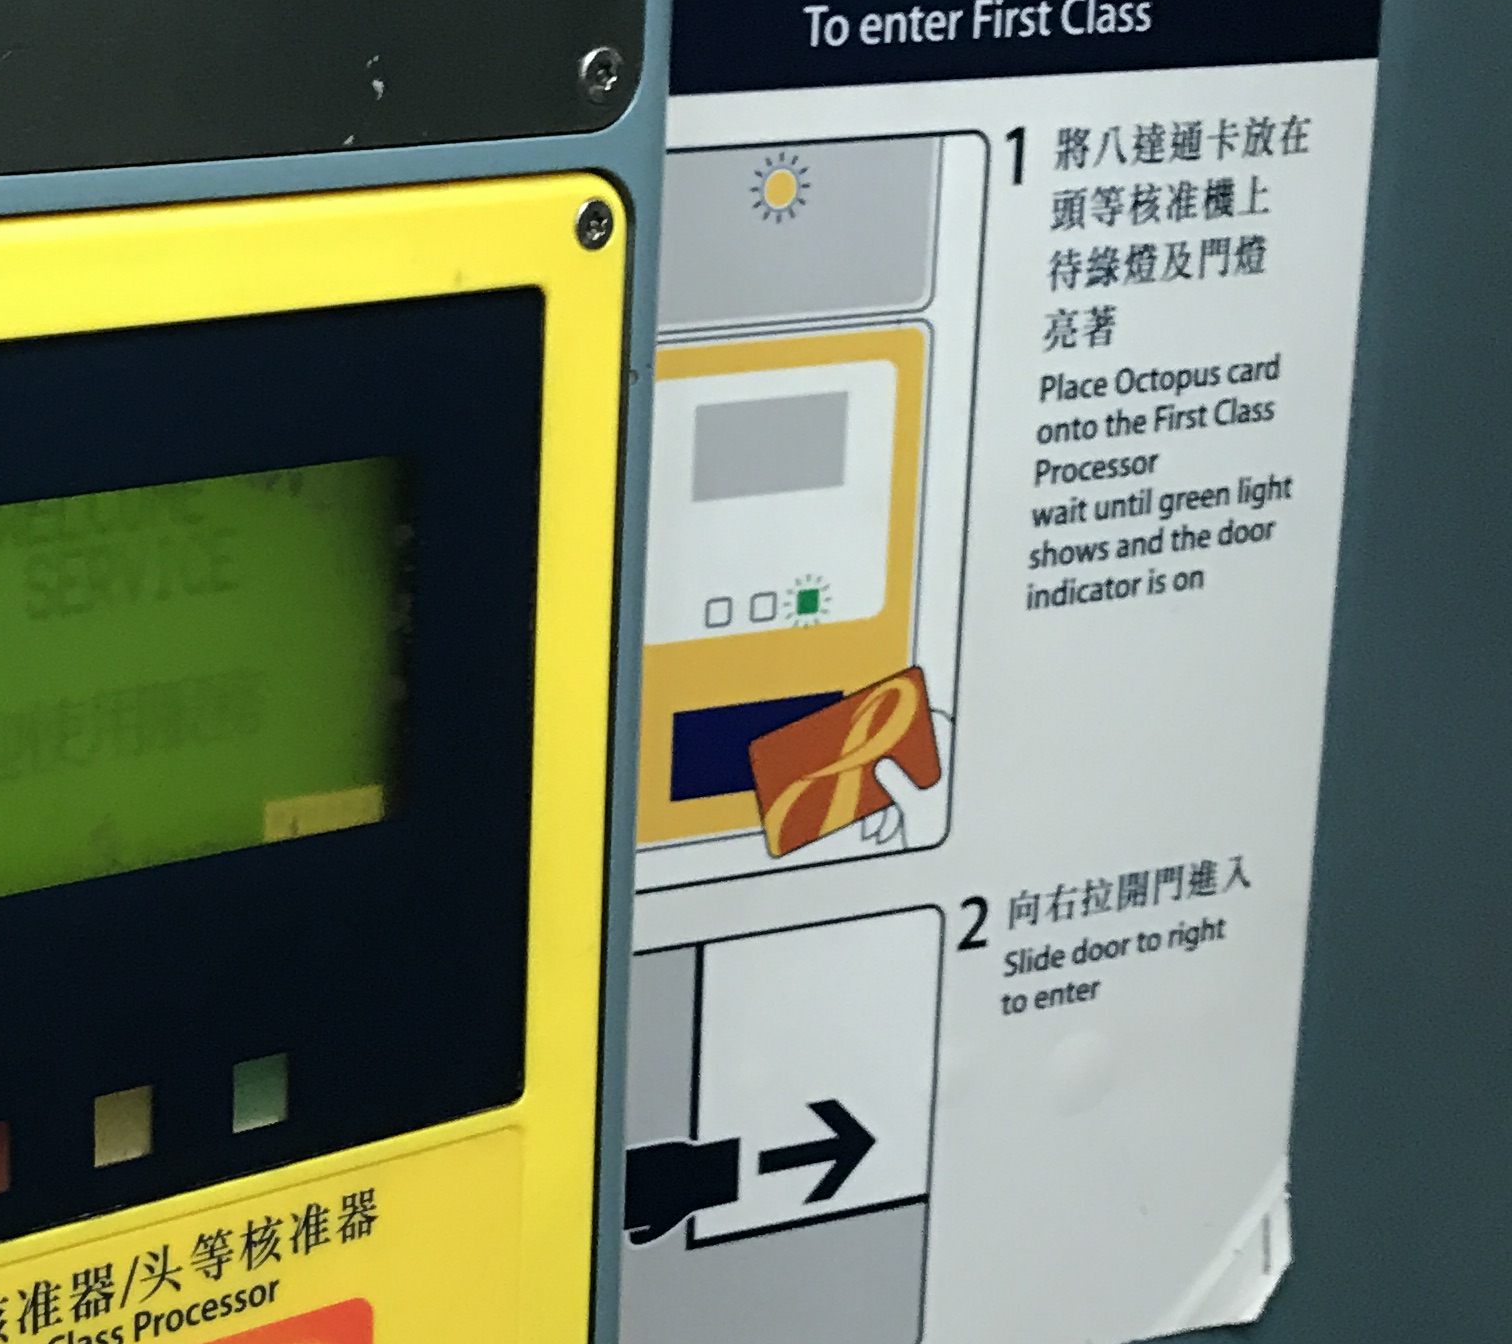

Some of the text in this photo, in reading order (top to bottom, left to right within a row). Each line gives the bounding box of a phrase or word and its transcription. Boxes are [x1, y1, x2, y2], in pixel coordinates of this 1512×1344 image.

[803, 4, 849, 48] To
[859, 5, 964, 45] enter
[1005, 124, 1027, 187] 1
[1049, 174, 1271, 232] 頭等核准機上
[1039, 352, 1282, 404] Place Octopus card
[1036, 396, 1276, 445] onto the First Class
[1034, 453, 1161, 488] Processor
[1032, 473, 1293, 529] wait until green light
[23, 524, 241, 620] SERVICE
[1027, 517, 1277, 571] shows and the door
[1025, 567, 1205, 611] indicator is on
[1008, 853, 1252, 931] 向右拉開門進入
[958, 895, 989, 951] 2
[1002, 918, 1227, 978] Slide door to right
[1001, 979, 1102, 1015] to enter
[133, 1277, 281, 1344] Processor
